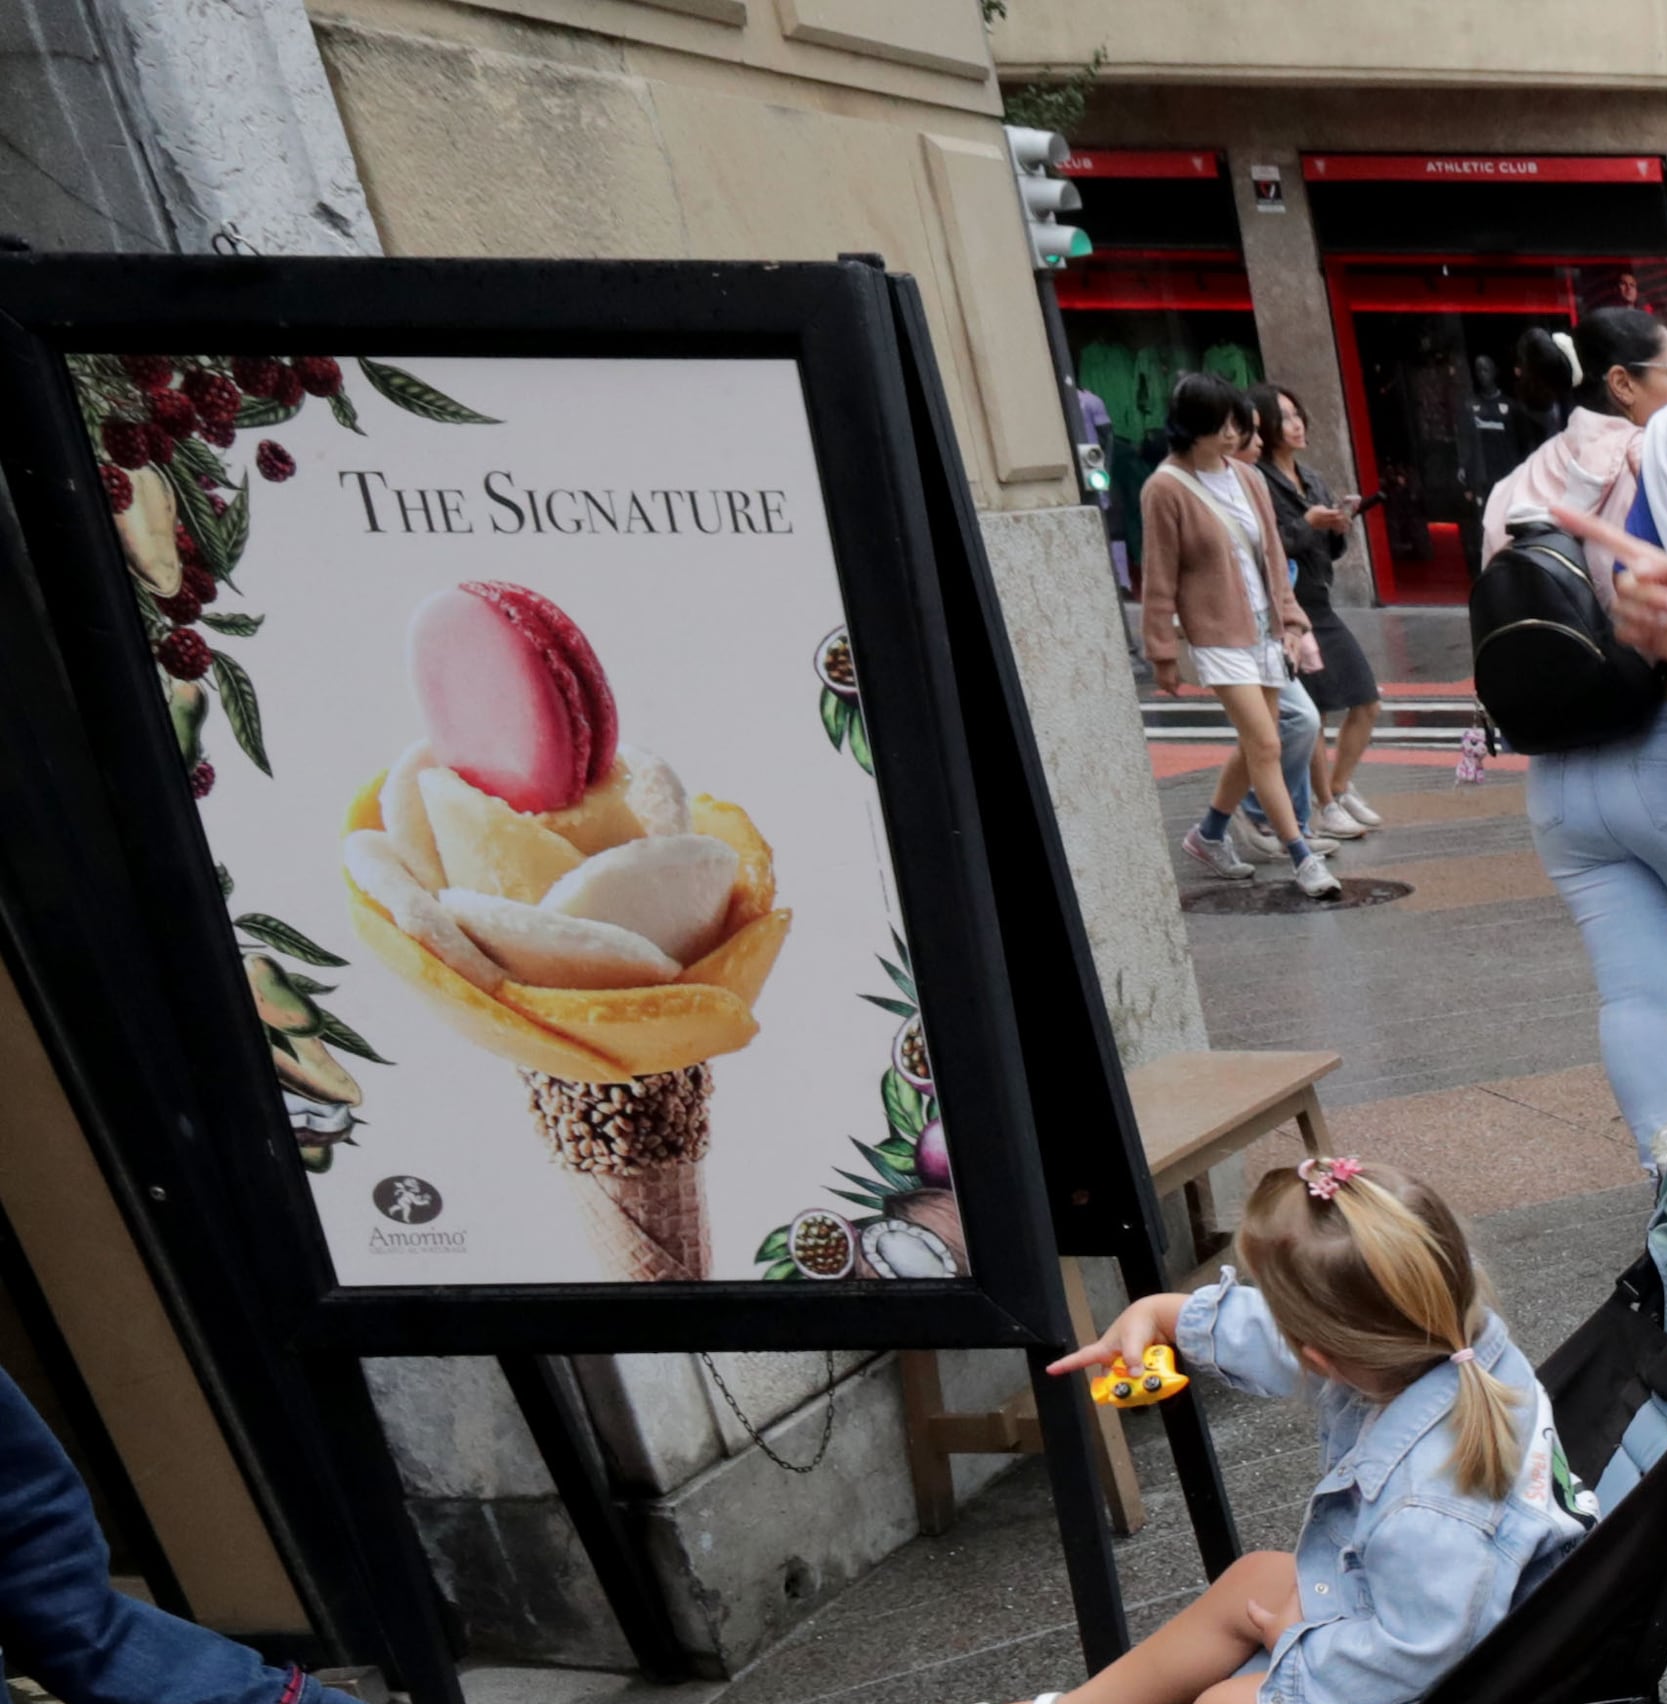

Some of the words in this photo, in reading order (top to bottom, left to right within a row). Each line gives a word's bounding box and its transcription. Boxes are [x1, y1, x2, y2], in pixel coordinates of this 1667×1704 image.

[1426, 161, 1494, 174] ATHLETIC
[1499, 161, 1538, 174] CLUB
[369, 1226, 466, 1247] Amorino
